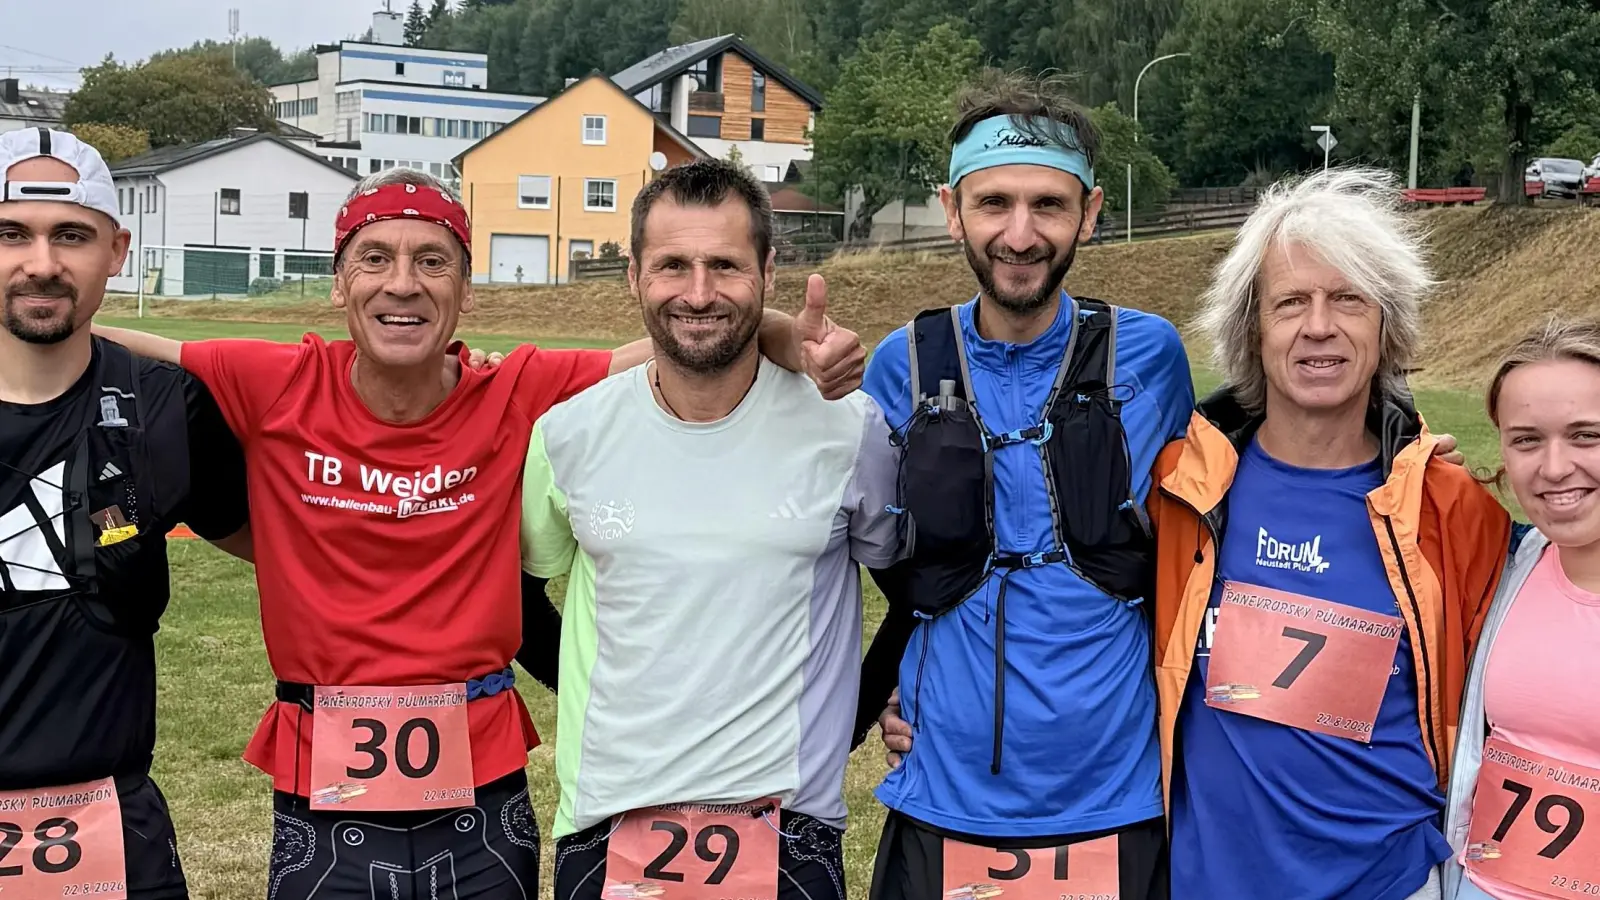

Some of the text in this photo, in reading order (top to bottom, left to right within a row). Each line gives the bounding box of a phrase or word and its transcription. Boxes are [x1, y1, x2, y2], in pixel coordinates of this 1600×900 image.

[304, 451, 477, 498] TB Weiden
[599, 528, 622, 540] VCM
[1257, 526, 1321, 564] FORUM
[1256, 558, 1311, 572] Neustadt Plus
[1272, 626, 1327, 690] 7
[346, 717, 440, 779] 30
[0, 817, 82, 877] 28
[1491, 778, 1585, 860] 79
[644, 820, 740, 885] 29
